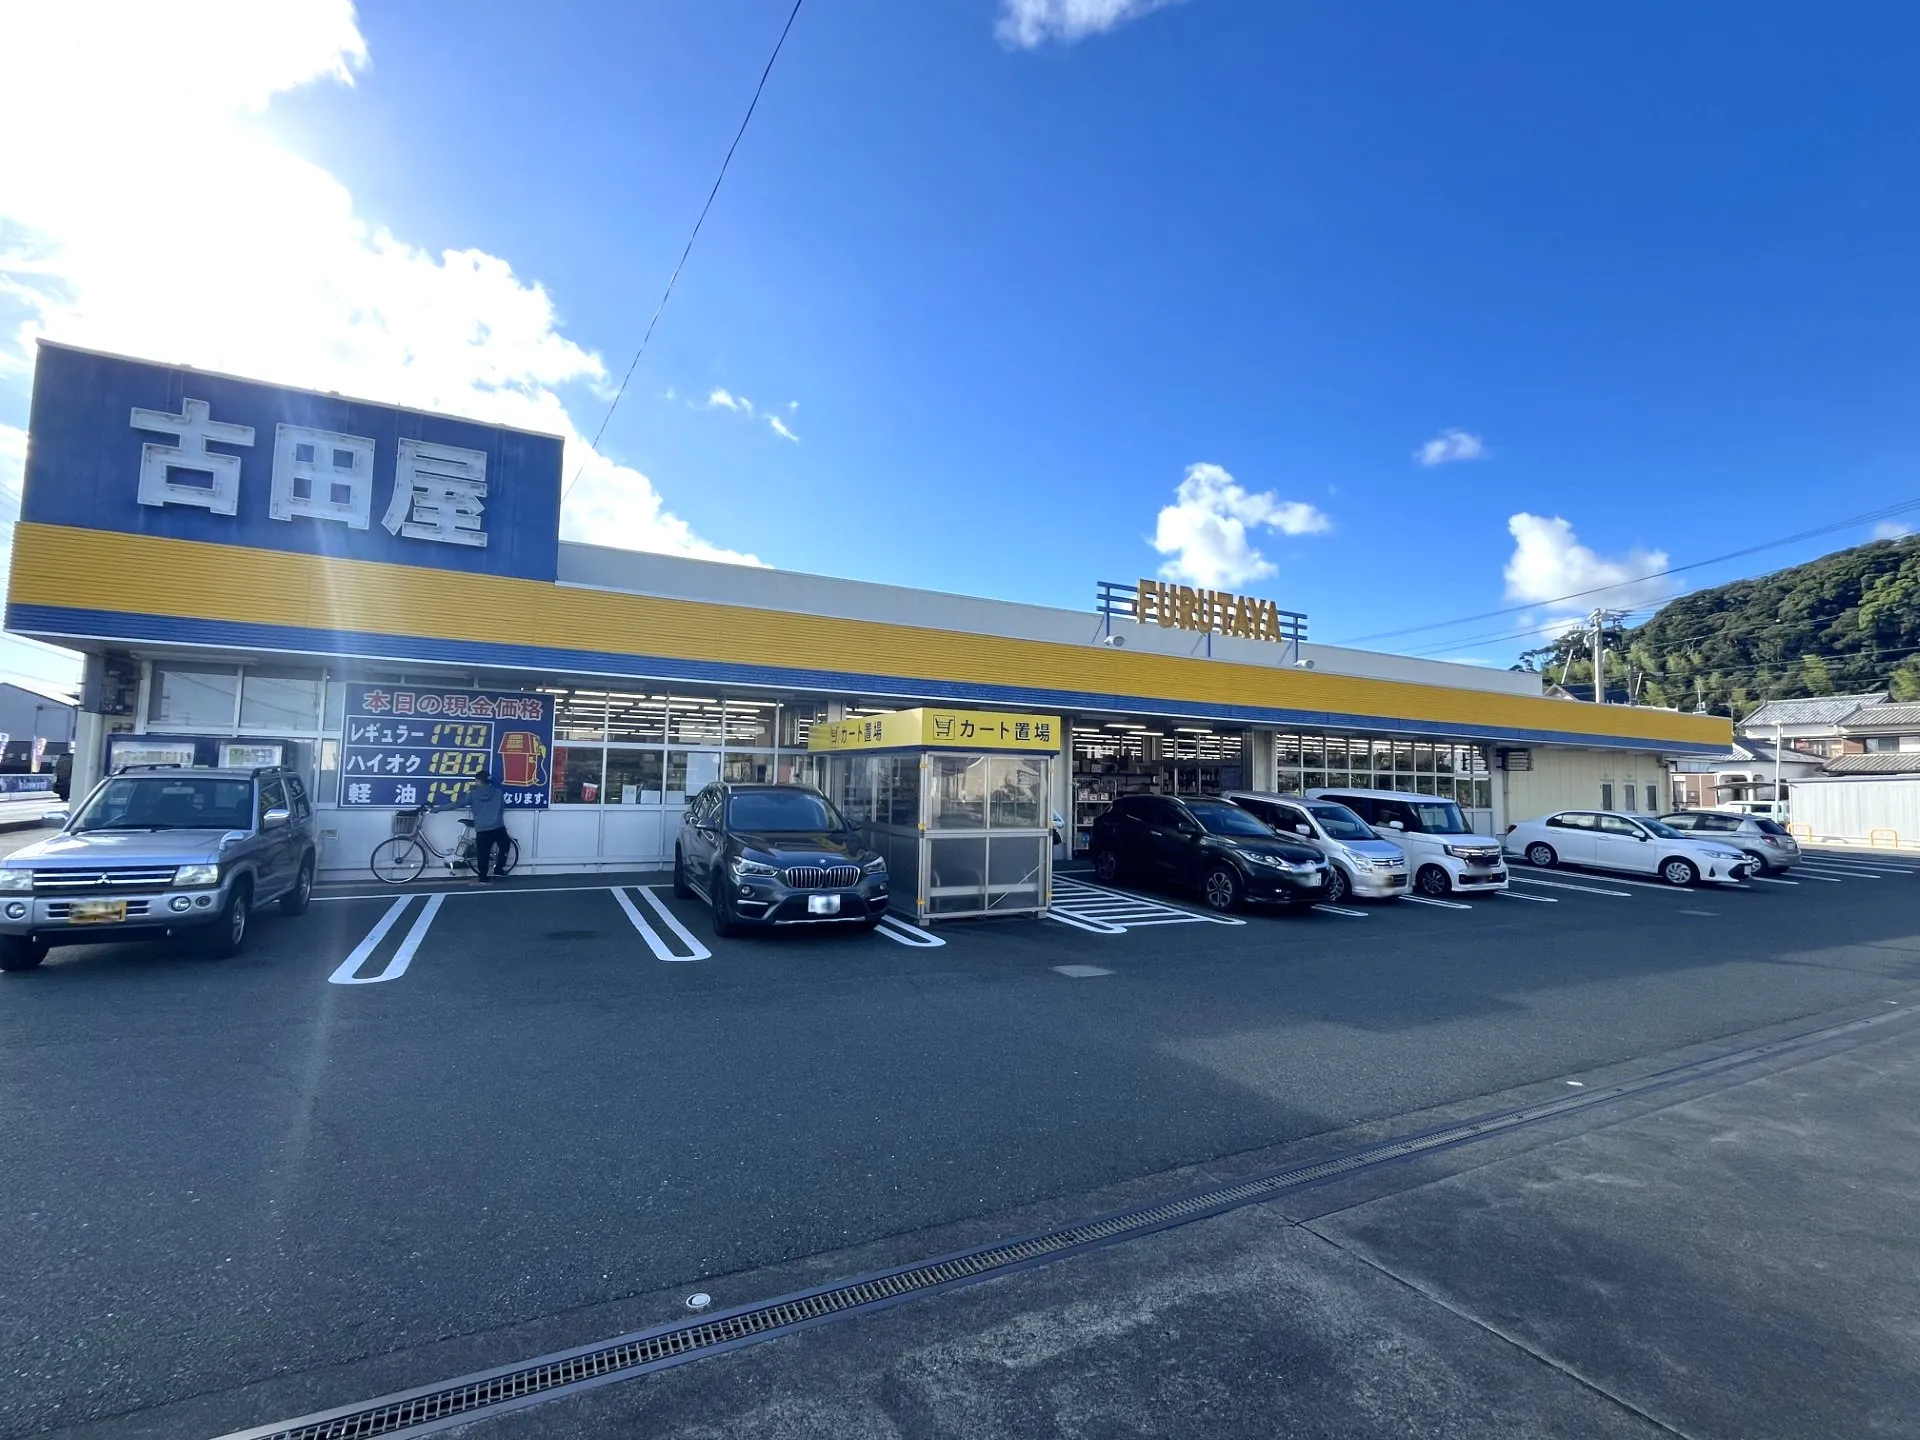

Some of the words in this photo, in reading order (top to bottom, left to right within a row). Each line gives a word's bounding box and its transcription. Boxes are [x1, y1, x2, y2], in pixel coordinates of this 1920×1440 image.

[129, 396, 488, 548] 古田屋
[1136, 578, 1282, 643] FURUTAYA
[362, 689, 544, 721] 本日の現金価格
[350, 722, 425, 744] レギュラー
[430, 723, 488, 748] 170
[840, 720, 882, 744] カート置場
[959, 719, 1051, 743] カート置場
[346, 751, 421, 774] ハイオク
[428, 751, 486, 775] 180
